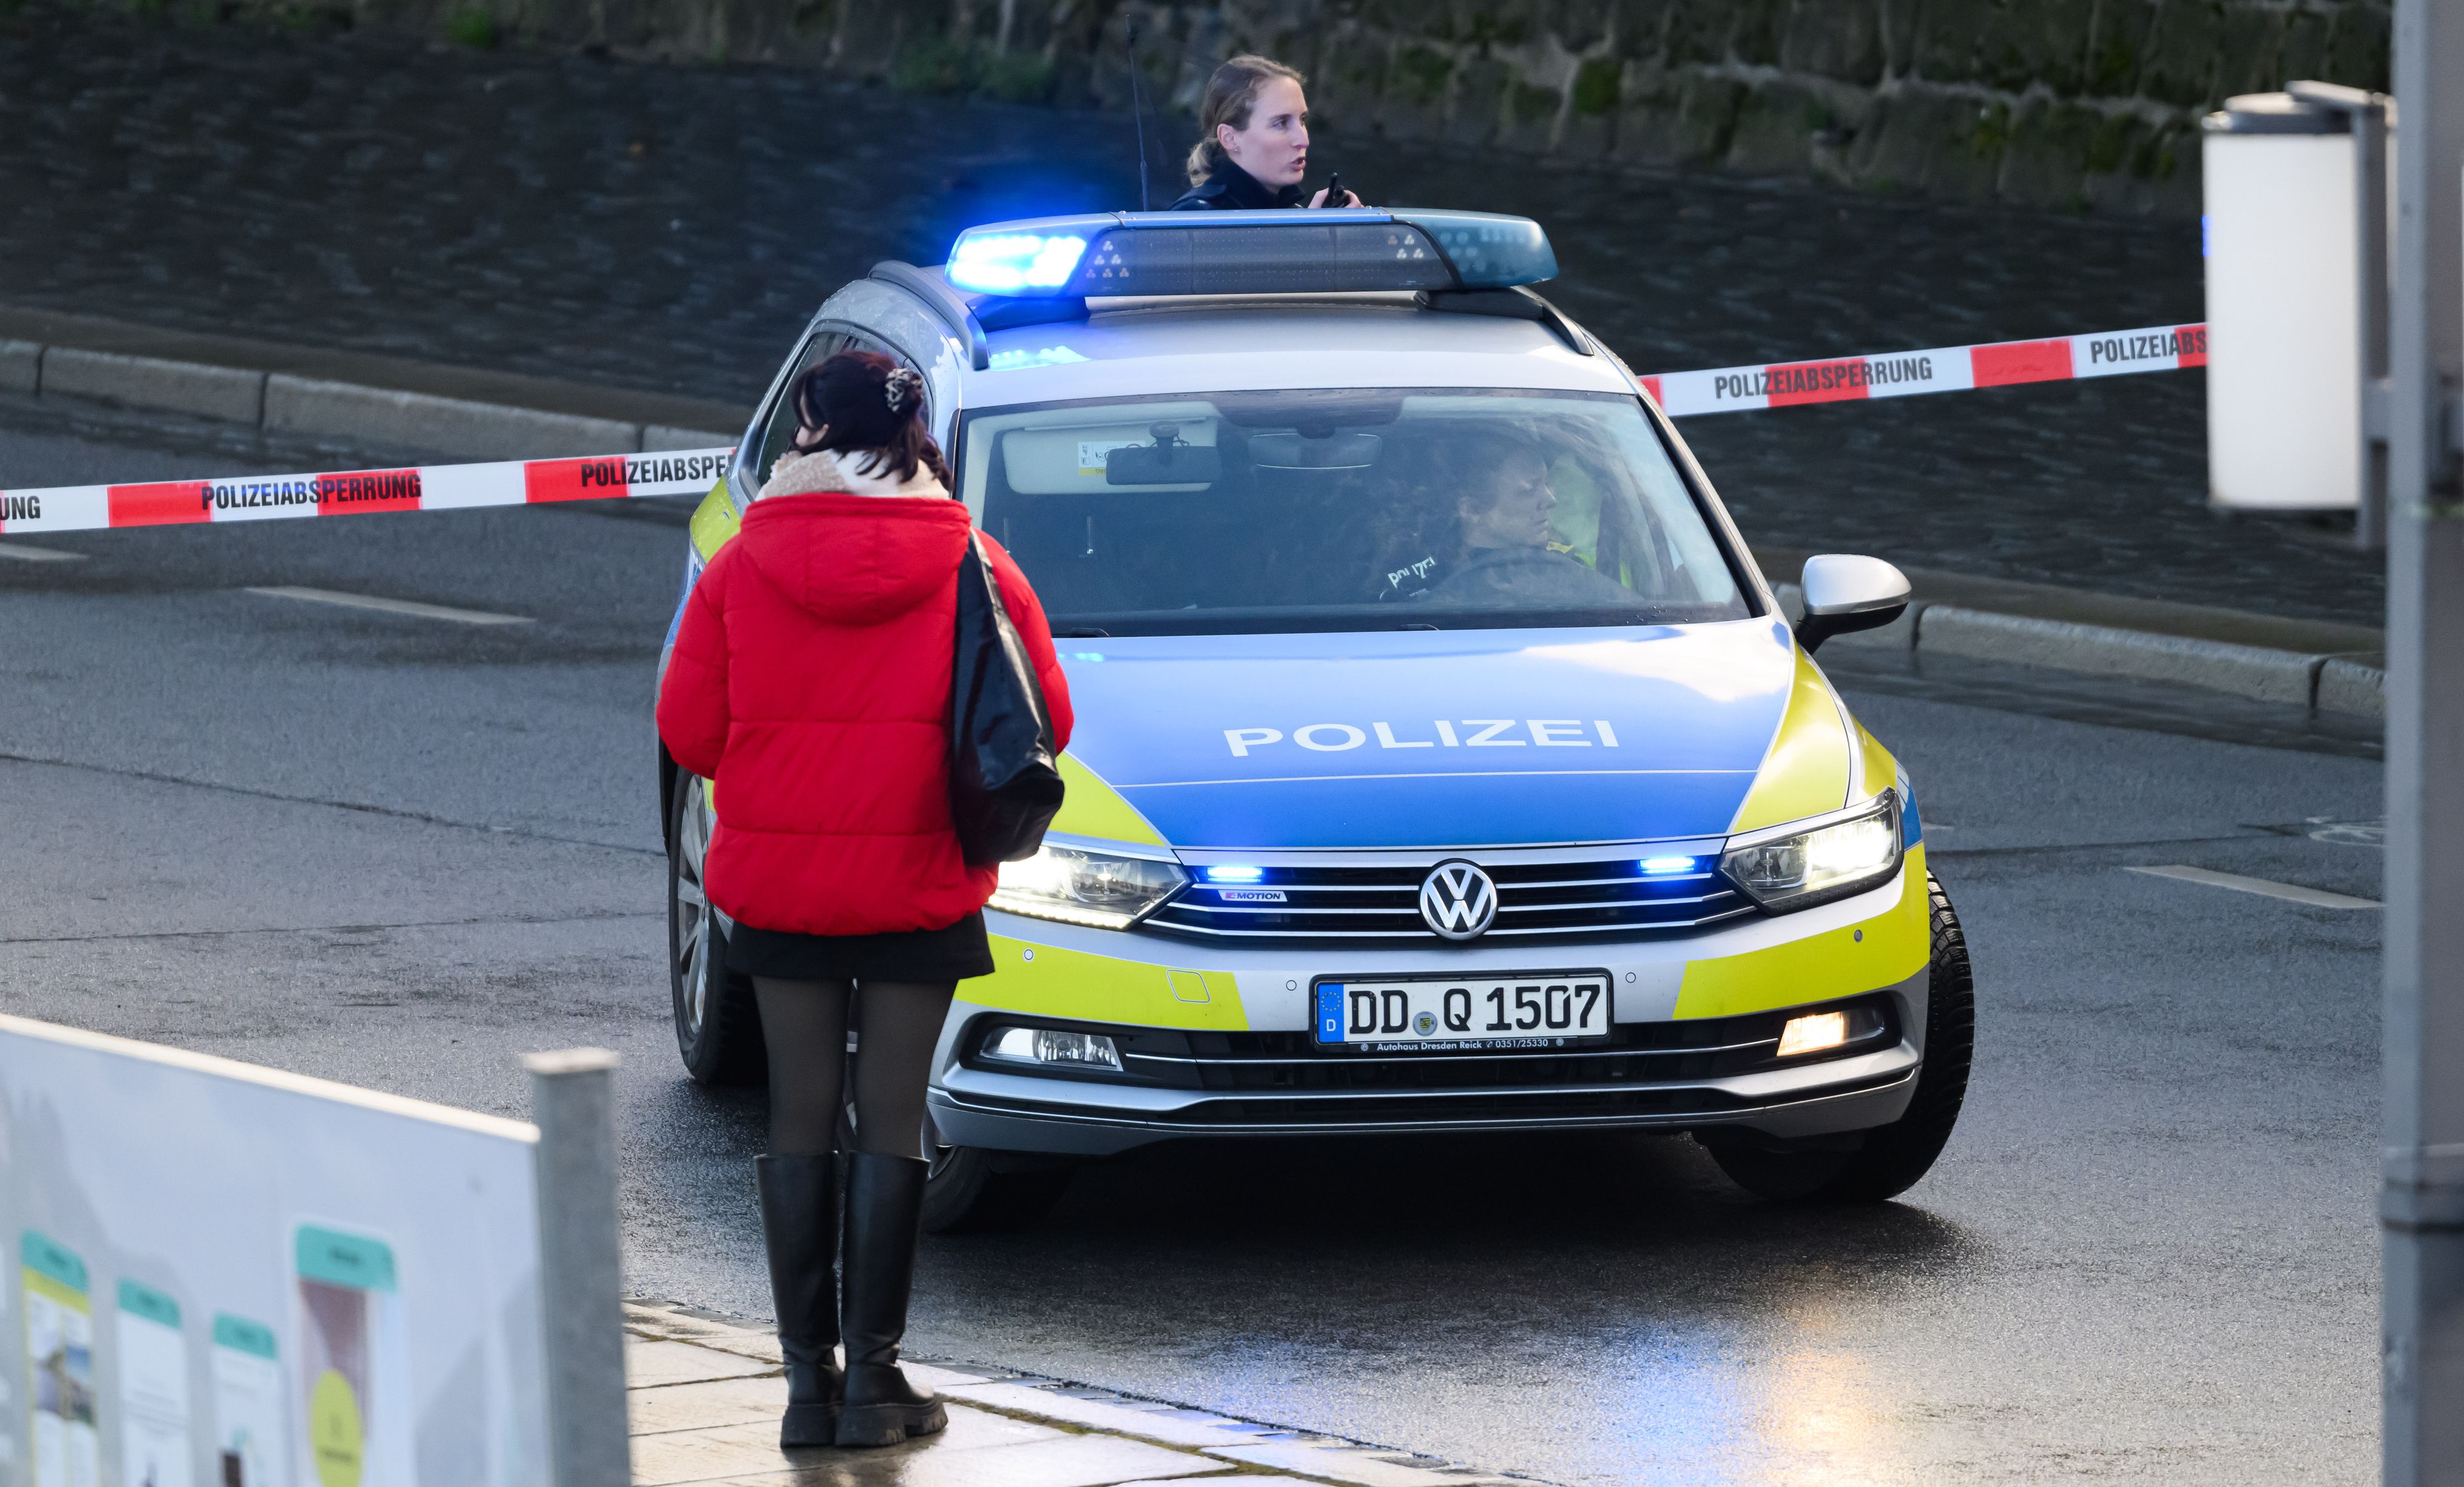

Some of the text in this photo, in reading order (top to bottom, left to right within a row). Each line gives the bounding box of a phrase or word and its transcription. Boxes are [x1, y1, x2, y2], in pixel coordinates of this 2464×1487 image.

[1714, 356, 1932, 399] POLIZEIABSPERRUNG
[202, 473, 421, 510] POLIZEIABSPERRUNG
[1223, 719, 1619, 757] POLIZEI
[1326, 1019, 1336, 1032] D
[1349, 984, 1600, 1034] DD Q 1507
[1377, 1042, 1418, 1051] Autohaus
[1420, 1041, 1457, 1050] Dresden
[1459, 1040, 1482, 1049] Reick
[1495, 1039, 1549, 1048] 0351/25330
